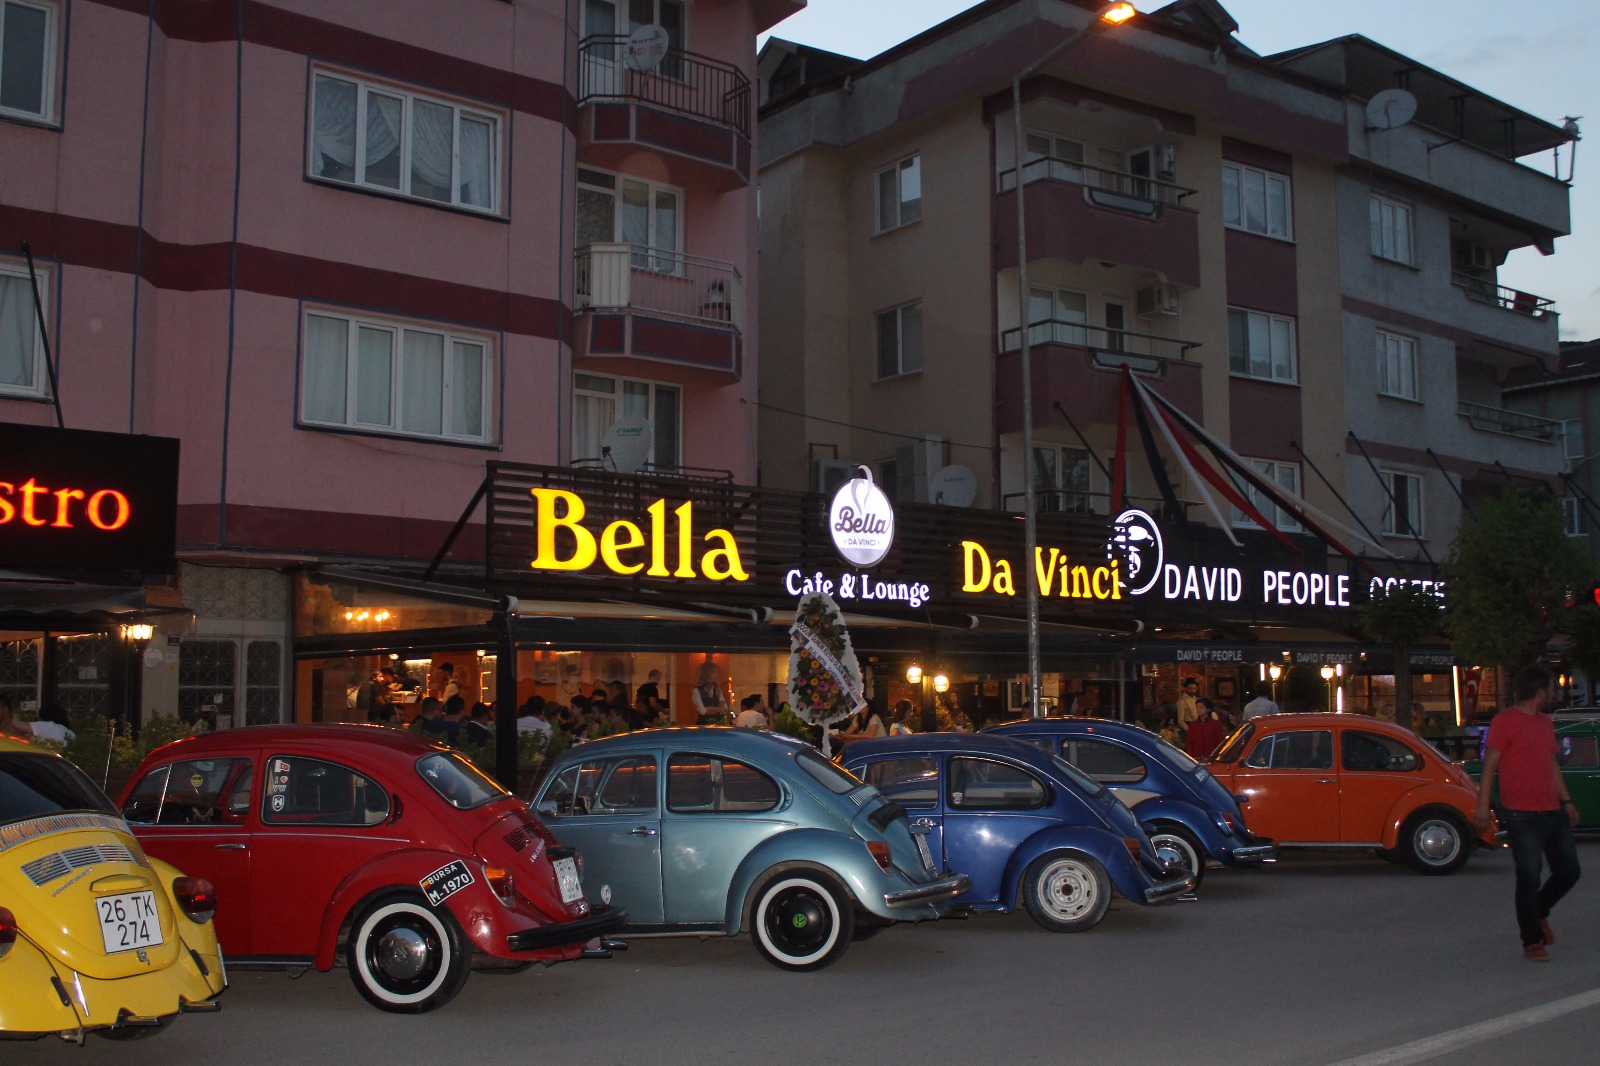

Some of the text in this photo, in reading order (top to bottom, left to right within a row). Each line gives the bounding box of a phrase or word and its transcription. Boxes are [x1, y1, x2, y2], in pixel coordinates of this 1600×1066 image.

[530, 487, 750, 581] Bella
[834, 505, 888, 534] Bella
[847, 538, 877, 546] DA VINCI
[960, 540, 1122, 600] Da Vinci
[785, 569, 930, 608] Cafe & Lounge
[1164, 564, 1243, 602] DAVID
[1263, 570, 1350, 607] PEOPLE
[1176, 649, 1242, 661] DAVID PEOPLE
[1296, 652, 1353, 663] DAVID PEOPLE
[1409, 655, 1454, 665] AVID PEOPLE
[426, 865, 459, 885] BURSA
[429, 873, 471, 903] M-1970
[101, 894, 155, 924] 26 TK
[117, 920, 151, 947] 274
